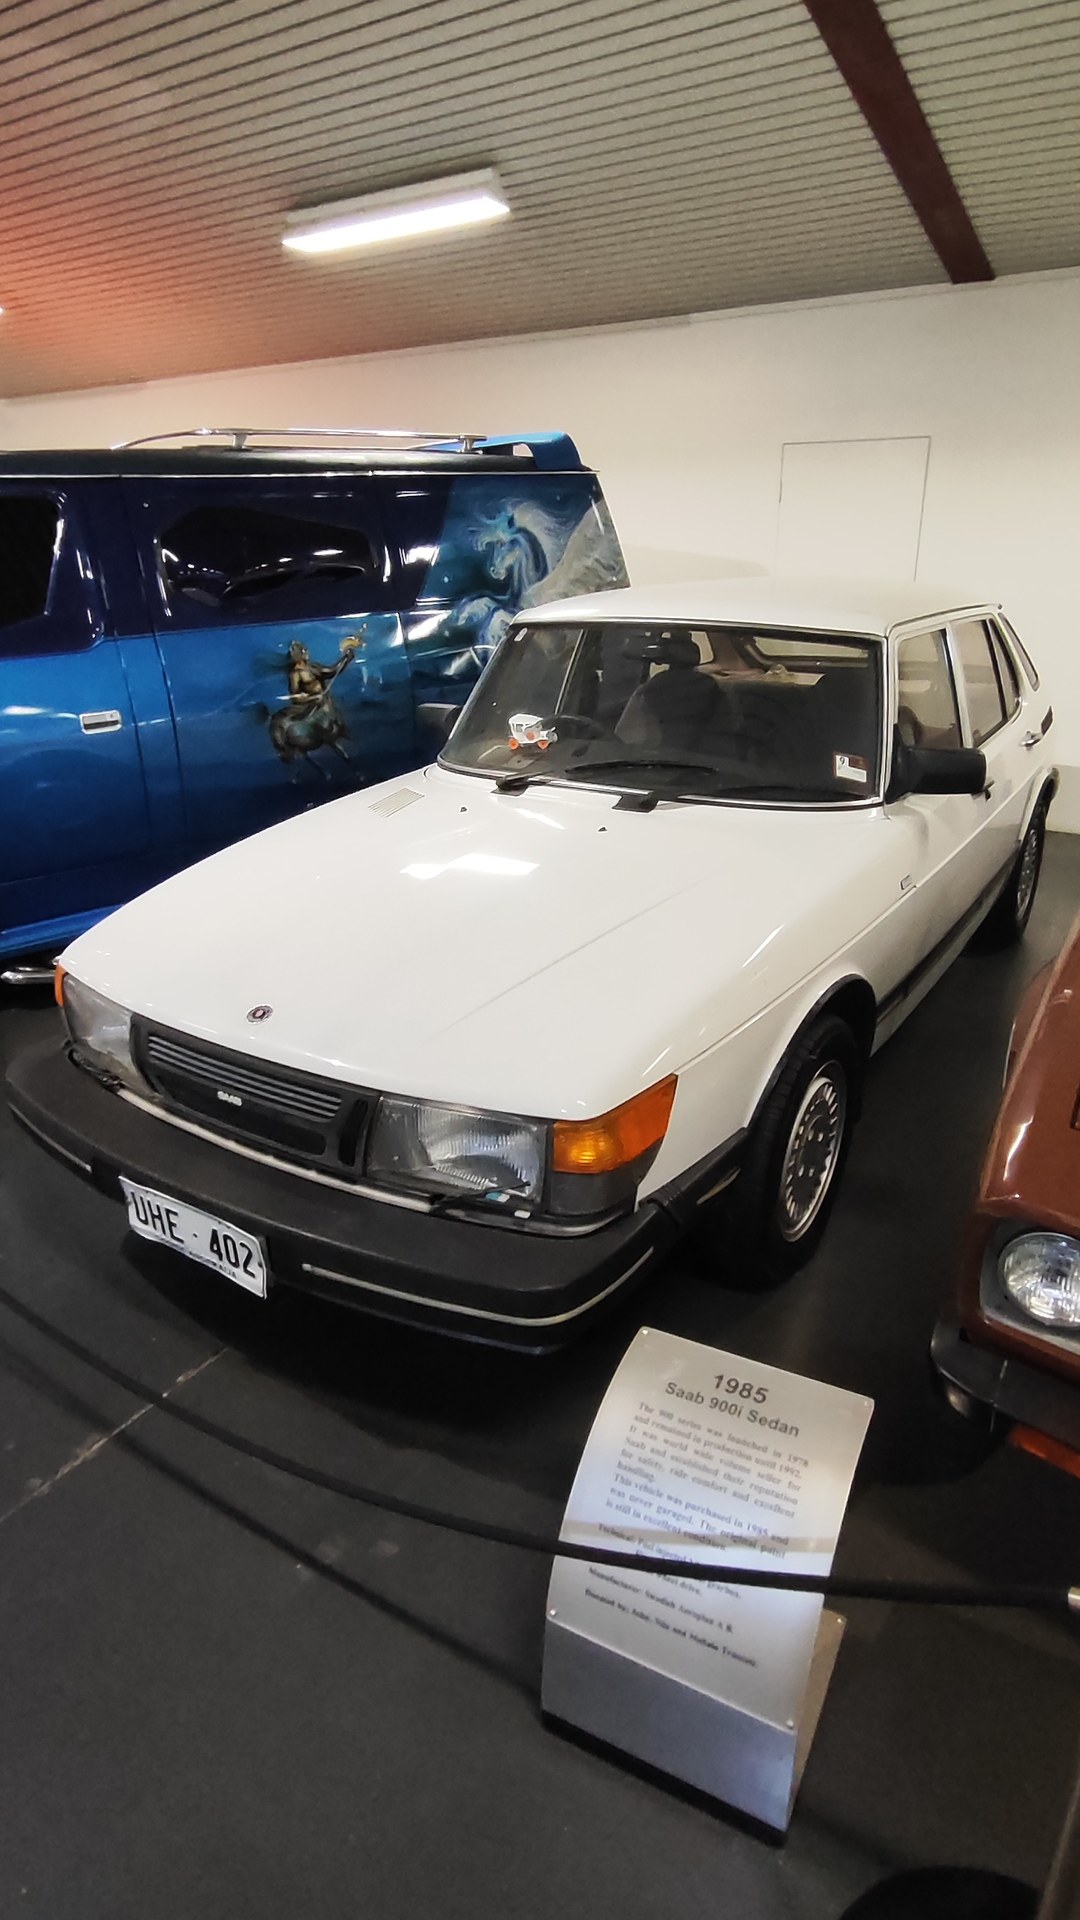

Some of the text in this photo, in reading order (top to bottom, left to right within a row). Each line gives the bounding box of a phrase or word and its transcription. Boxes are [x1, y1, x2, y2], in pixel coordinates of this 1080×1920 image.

[130, 1191, 256, 1279] UHE 402
[664, 1381, 800, 1438] Saab 900i Sedan
[713, 1373, 770, 1404] 1985
[628, 1424, 802, 1492] It was world wide volume seller for
[633, 1414, 650, 1426] and
[650, 1420, 692, 1440] remained
[692, 1434, 702, 1444] in
[703, 1439, 753, 1462] production
[754, 1456, 778, 1470] until
[639, 1401, 655, 1414] The
[677, 1417, 702, 1431] series
[706, 1427, 723, 1438] was
[726, 1432, 769, 1454] launched
[772, 1449, 782, 1459] in
[620, 1447, 633, 1460] for
[669, 1467, 689, 1480] ride
[690, 1475, 729, 1495] comfort
[731, 1490, 750, 1503] and
[753, 1498, 796, 1519] excellent
[625, 1435, 798, 1506] Saab and established their reputation
[605, 1498, 614, 1509] is
[615, 1503, 632, 1516] still
[632, 1508, 642, 1520] in
[643, 1514, 682, 1535] excellent
[609, 1486, 787, 1560] was never garaged. The original paint
[614, 1472, 790, 1546] This vehicle was purchased in 1985 and
